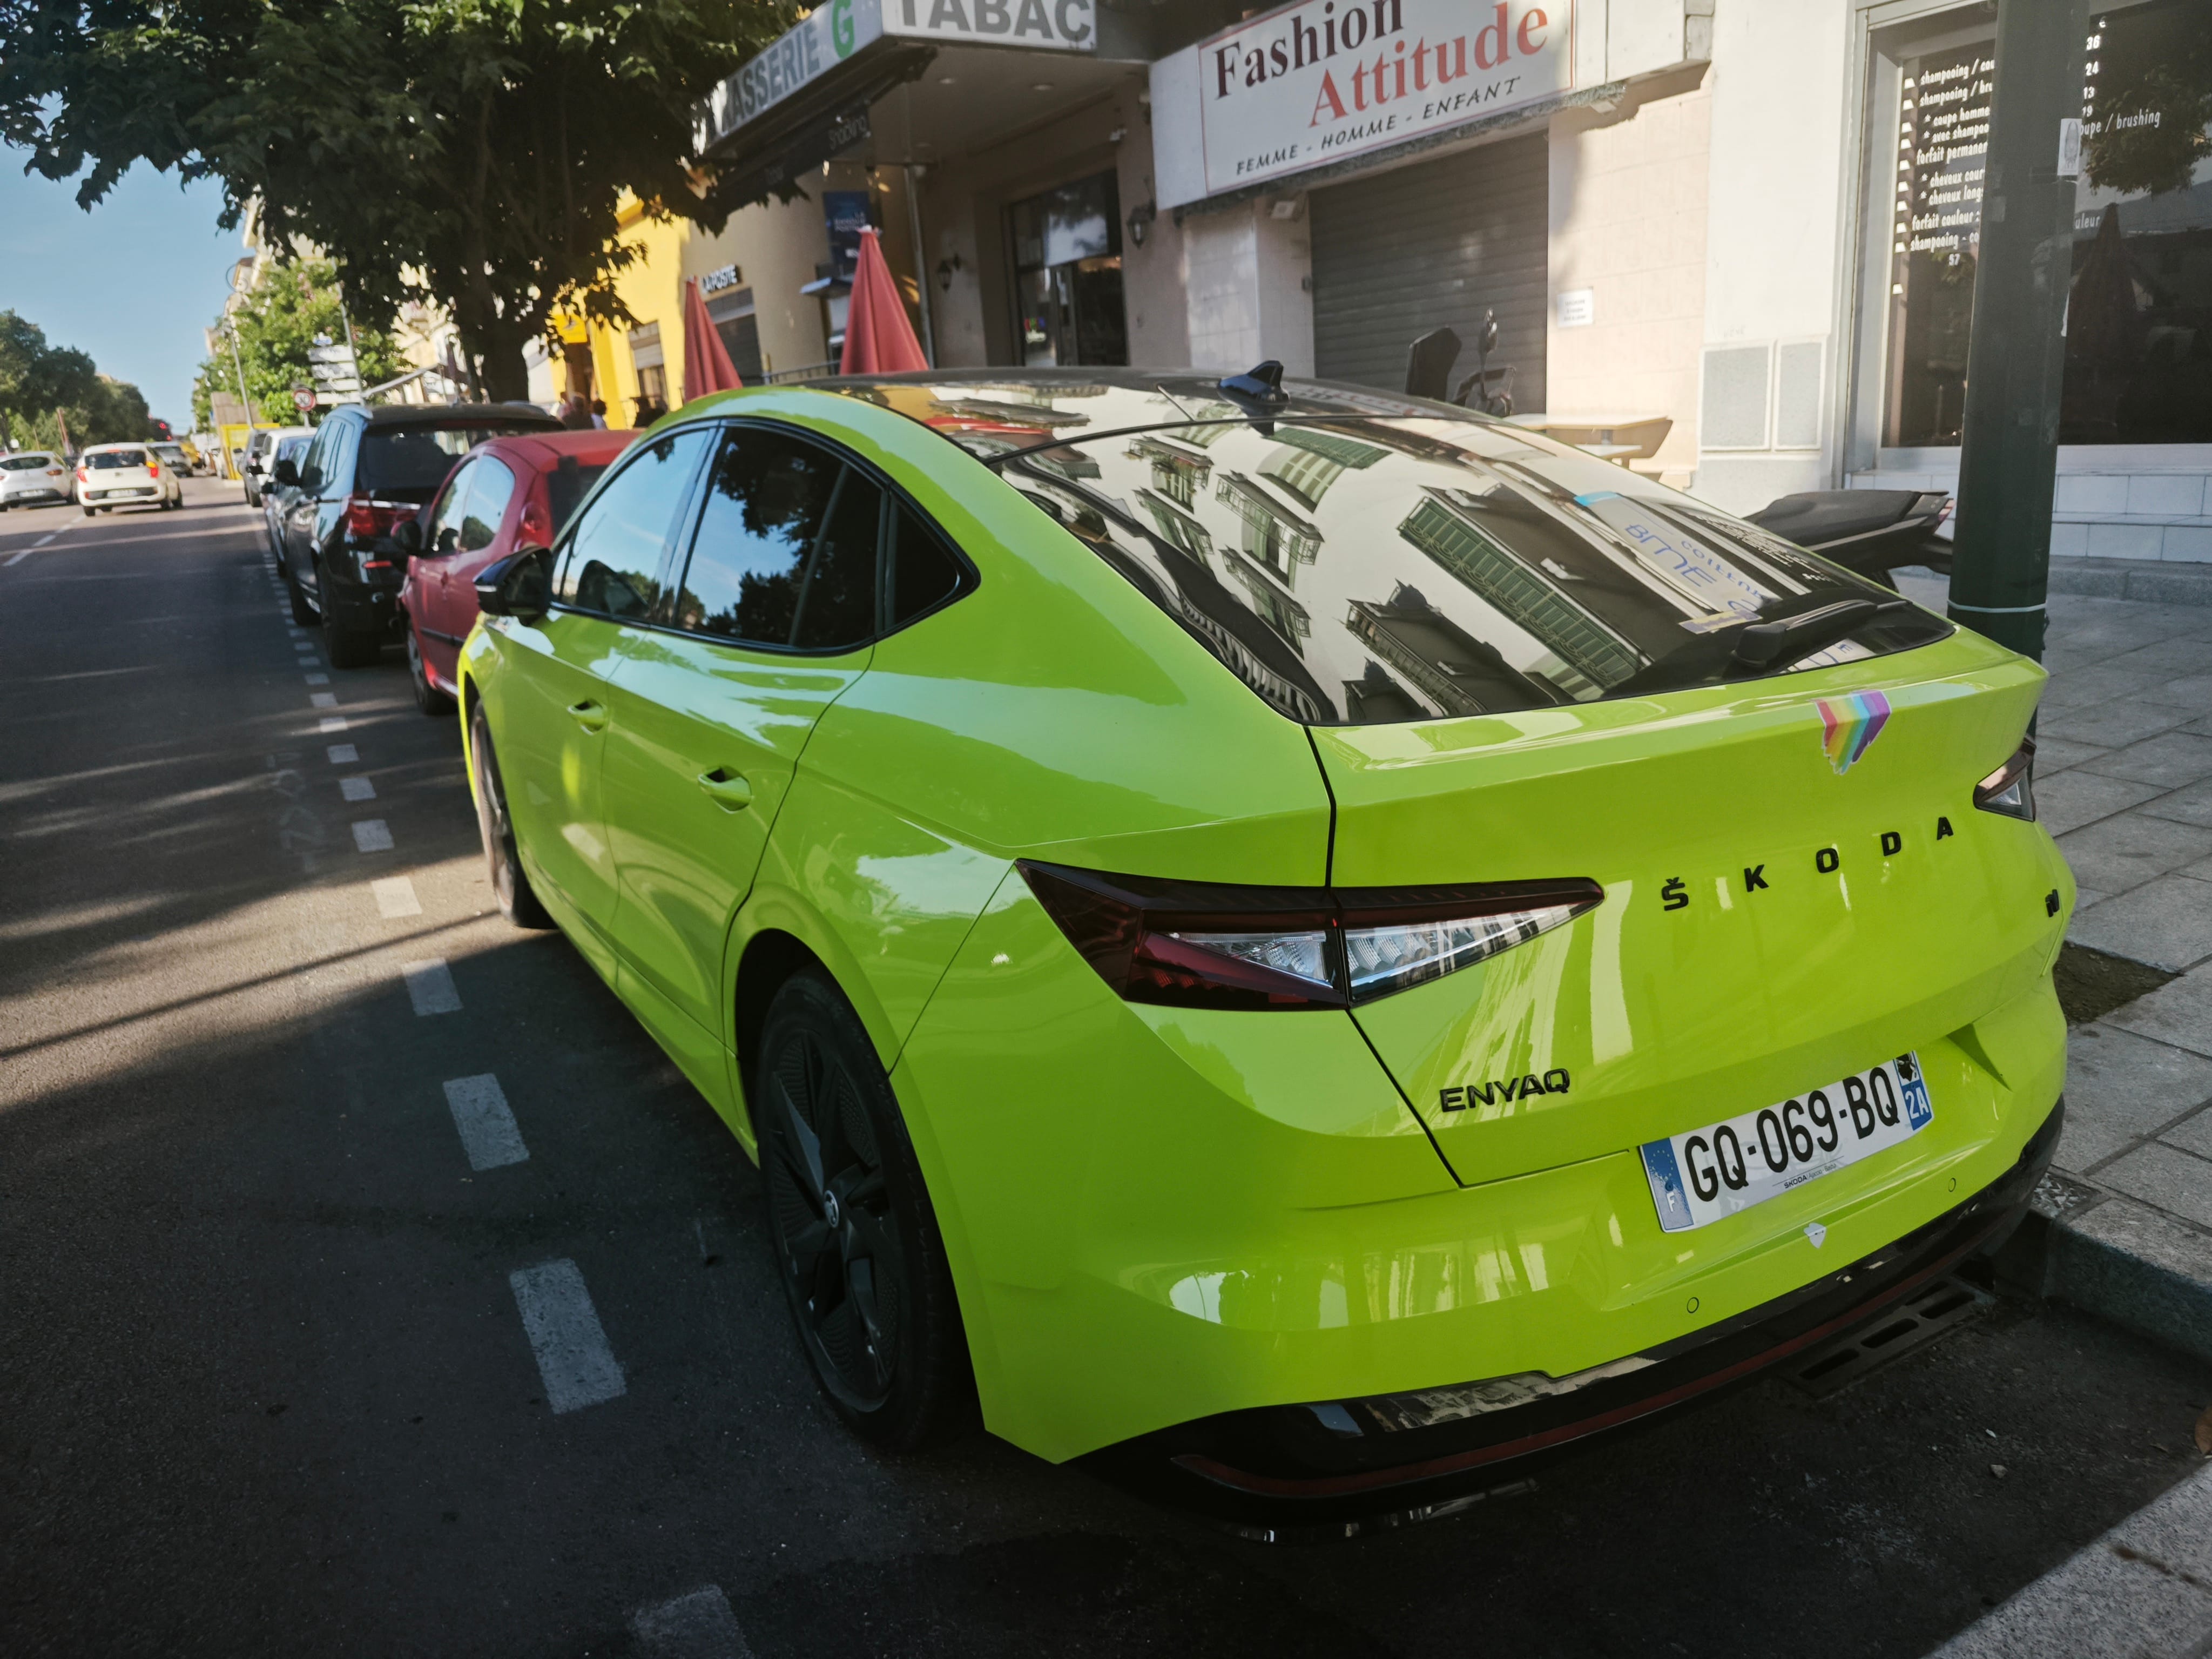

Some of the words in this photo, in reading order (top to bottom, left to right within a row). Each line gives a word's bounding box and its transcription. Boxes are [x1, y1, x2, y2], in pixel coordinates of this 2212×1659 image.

[1215, 0, 1404, 100] Fashion
[2086, 35, 2101, 50] 36
[1307, 1, 1549, 129] Attitude
[1920, 64, 1970, 86] shampooing
[2085, 60, 2099, 76] 24
[721, 22, 820, 132] ASSERIE
[1919, 86, 1968, 107] shampooing
[2083, 86, 2095, 99] 13
[1236, 144, 1298, 176] FEMME
[1321, 114, 1397, 151] HOMME
[1422, 76, 1521, 120] ENFANT
[1932, 112, 1958, 127] coupe
[1960, 106, 1990, 122] homme
[2116, 108, 2161, 130] brushing
[1931, 130, 1951, 144] avec
[1952, 123, 1990, 140] shampoo
[1917, 146, 1945, 165] forfait
[1930, 171, 1963, 188] cheveux
[1928, 189, 1961, 206] cheveux
[1912, 212, 1940, 231] forfait
[1941, 208, 1974, 227] couleur
[1910, 231, 1959, 253] shampooing
[1948, 253, 1960, 266] 57
[1661, 817, 1954, 911] ŠKODA
[1440, 1068, 1570, 1112] ENYAQ
[1905, 1088, 1929, 1118] 2A
[1684, 1067, 1900, 1202] GQ-069-BQ
